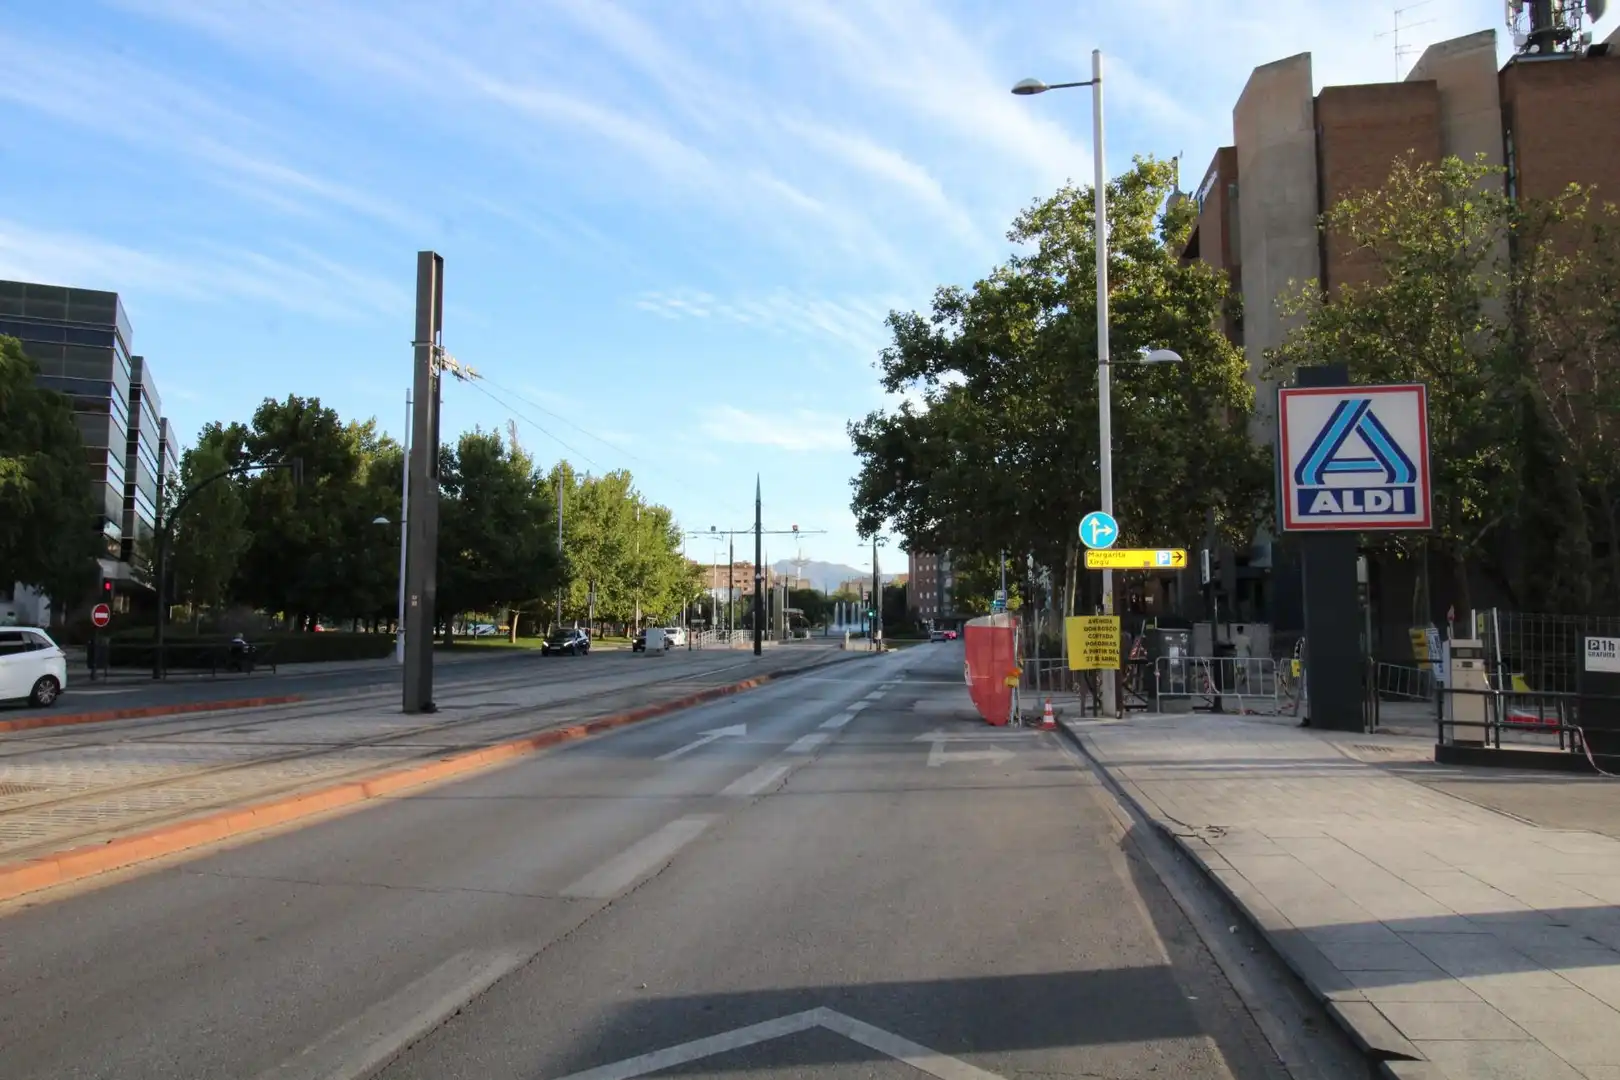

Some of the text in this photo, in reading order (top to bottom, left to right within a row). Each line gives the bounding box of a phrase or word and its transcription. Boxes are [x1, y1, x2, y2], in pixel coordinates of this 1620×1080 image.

[1309, 489, 1405, 513] ALDI
[1088, 551, 1126, 559] Margarita
[1601, 640, 1615, 651] 1h
